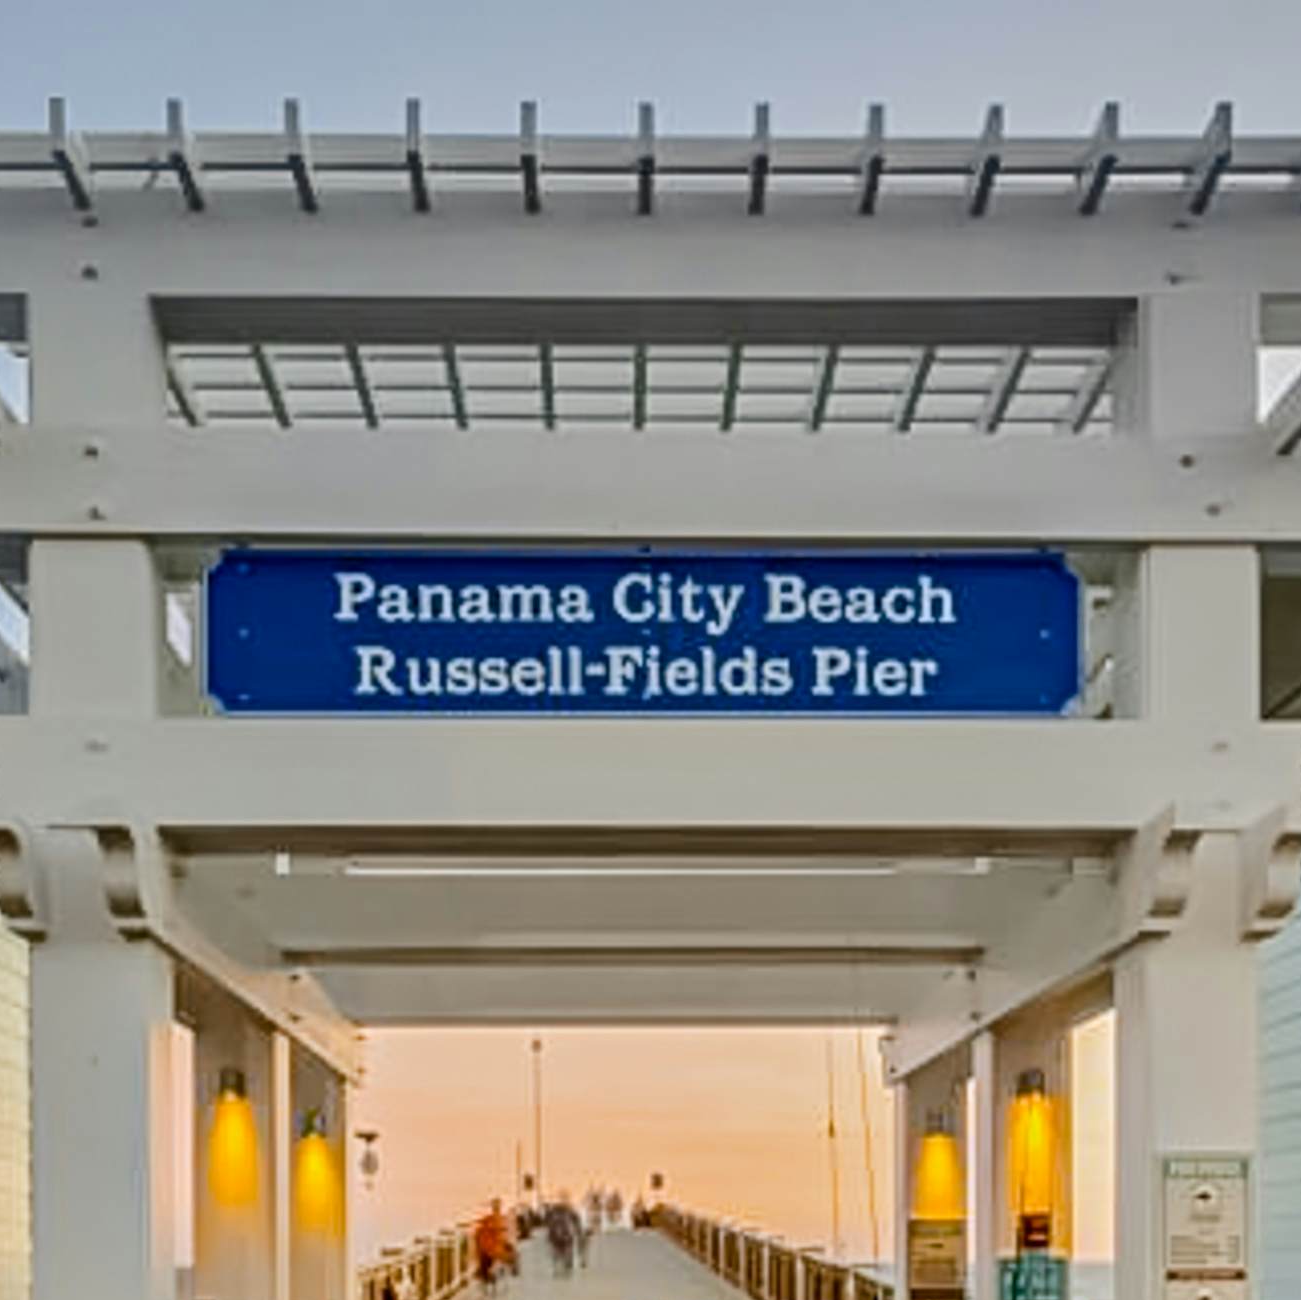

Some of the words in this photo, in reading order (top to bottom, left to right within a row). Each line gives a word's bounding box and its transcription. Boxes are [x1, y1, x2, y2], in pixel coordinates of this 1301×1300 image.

[333, 572, 595, 623] Panama
[612, 572, 745, 636] City
[763, 572, 957, 624] Beach
[353, 645, 794, 697] Russell-Fields
[811, 645, 940, 697] Pier
